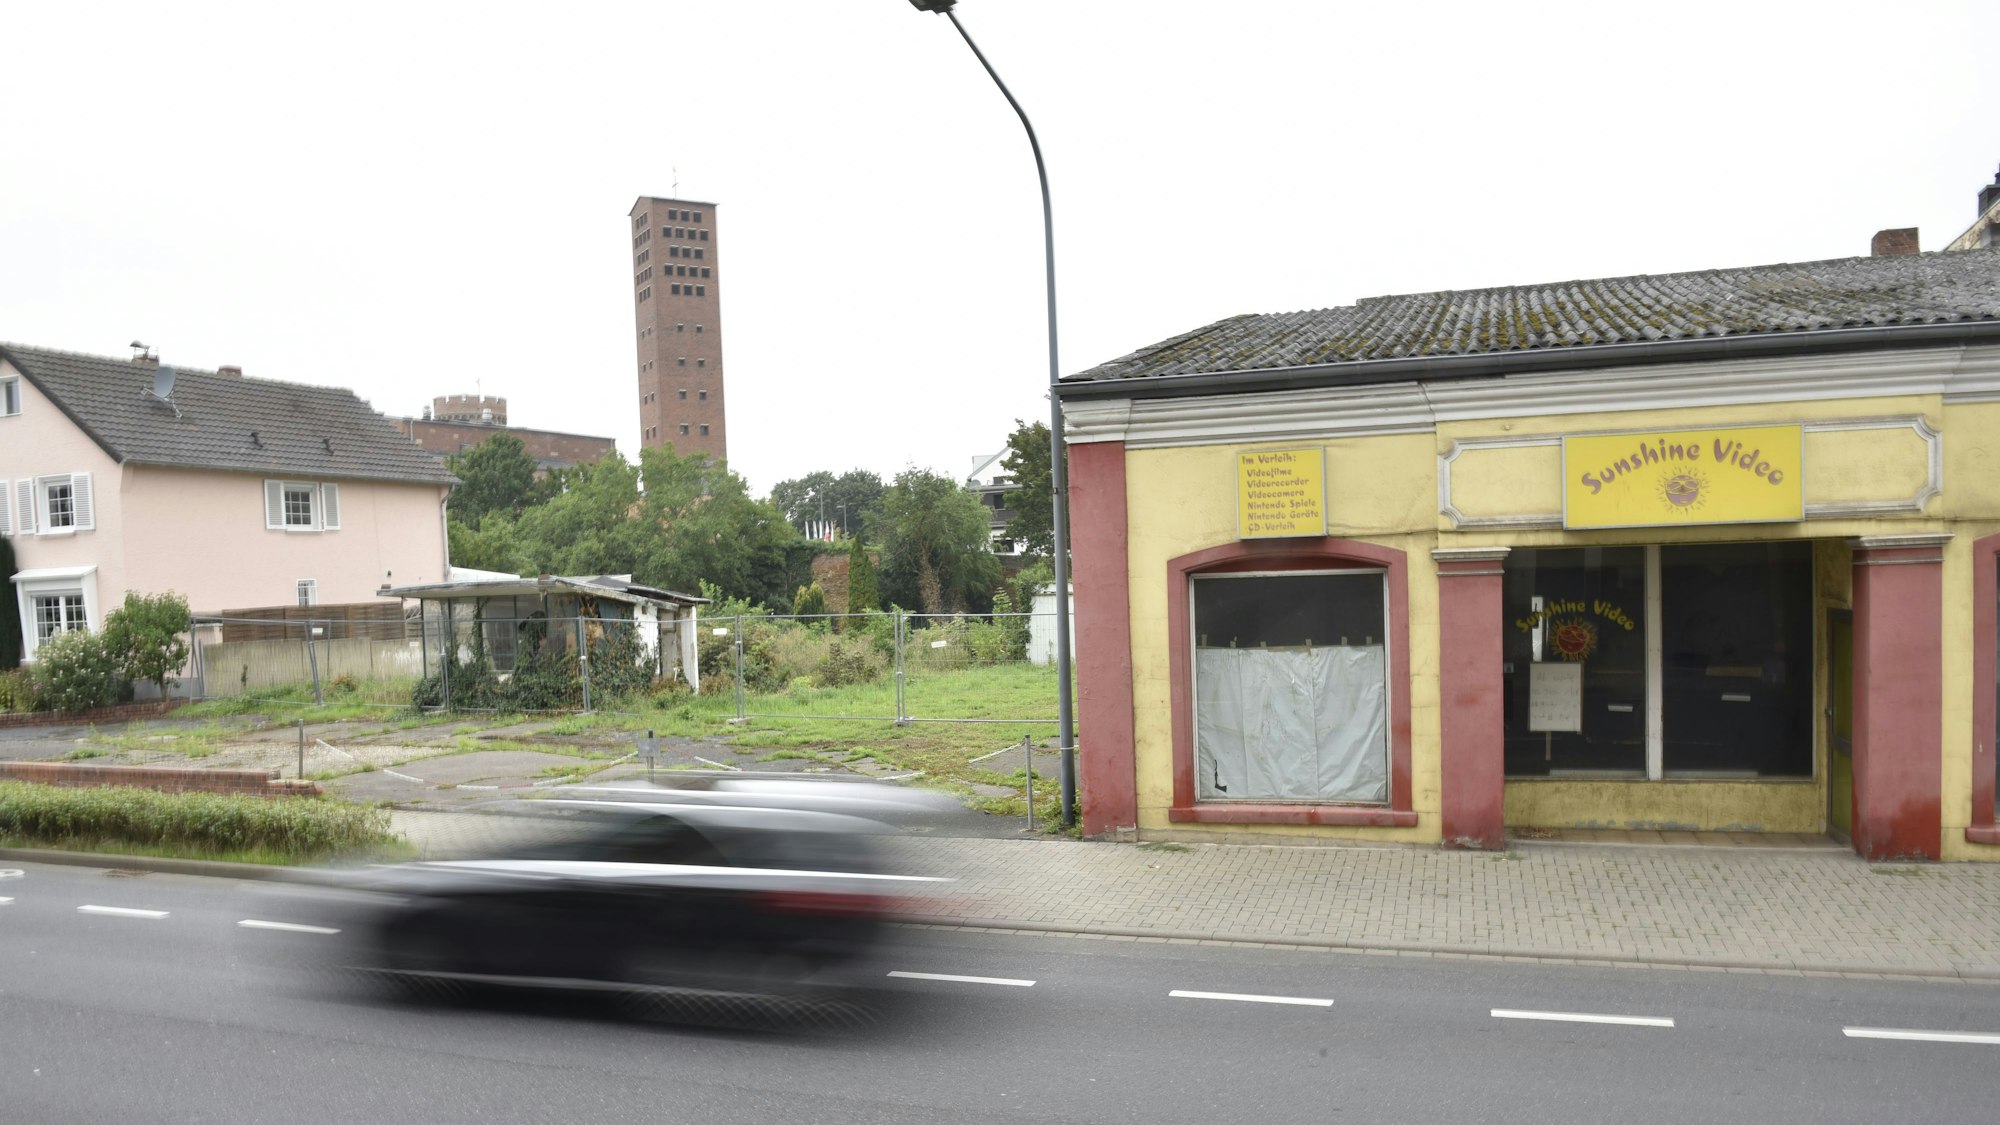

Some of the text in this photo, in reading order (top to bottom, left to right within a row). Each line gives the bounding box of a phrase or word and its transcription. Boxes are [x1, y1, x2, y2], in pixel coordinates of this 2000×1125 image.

[1242, 453, 1296, 464] Im Verleih:
[1581, 438, 1784, 495] Sunshine Video
[1247, 468, 1292, 478] Videofilme
[1247, 478, 1309, 488] Videorecorder
[1248, 490, 1304, 499] Videocamera
[1248, 499, 1316, 510] Nintendo Spiele
[1248, 510, 1319, 521] Nintendo Geräte
[1516, 598, 1634, 633] Sunshine Video
